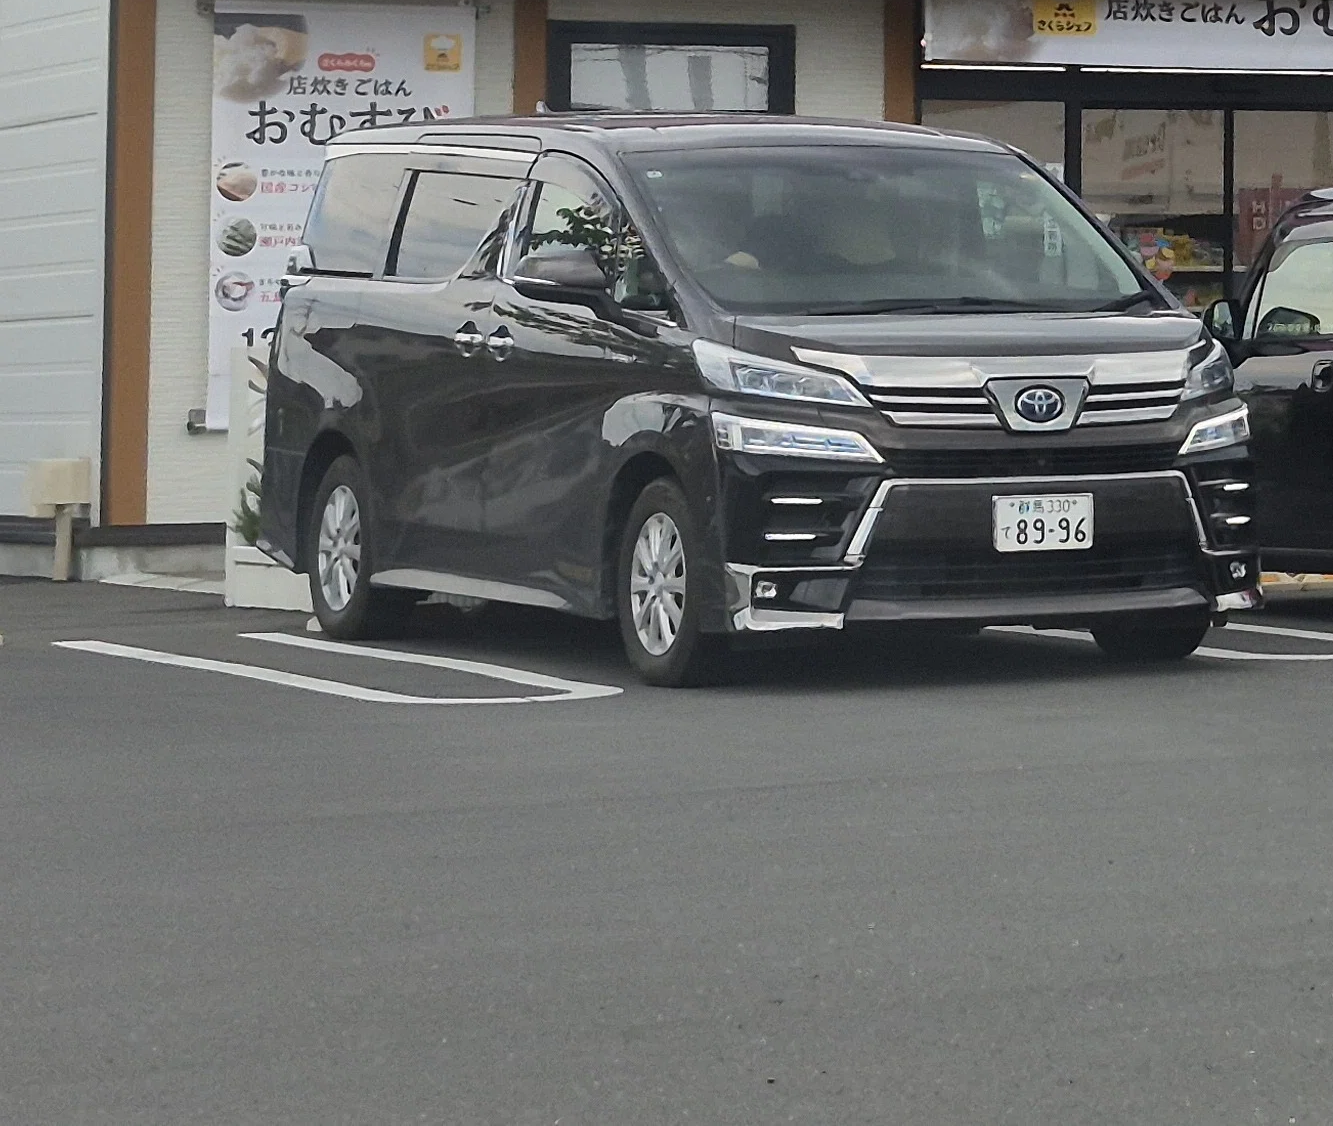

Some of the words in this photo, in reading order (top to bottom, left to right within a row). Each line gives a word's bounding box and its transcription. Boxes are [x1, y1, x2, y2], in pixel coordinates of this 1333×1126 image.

[1036, 19, 1092, 32] さくらシェフ
[287, 75, 413, 97] 店炊きごはん
[1016, 517, 1087, 545] 89-96
